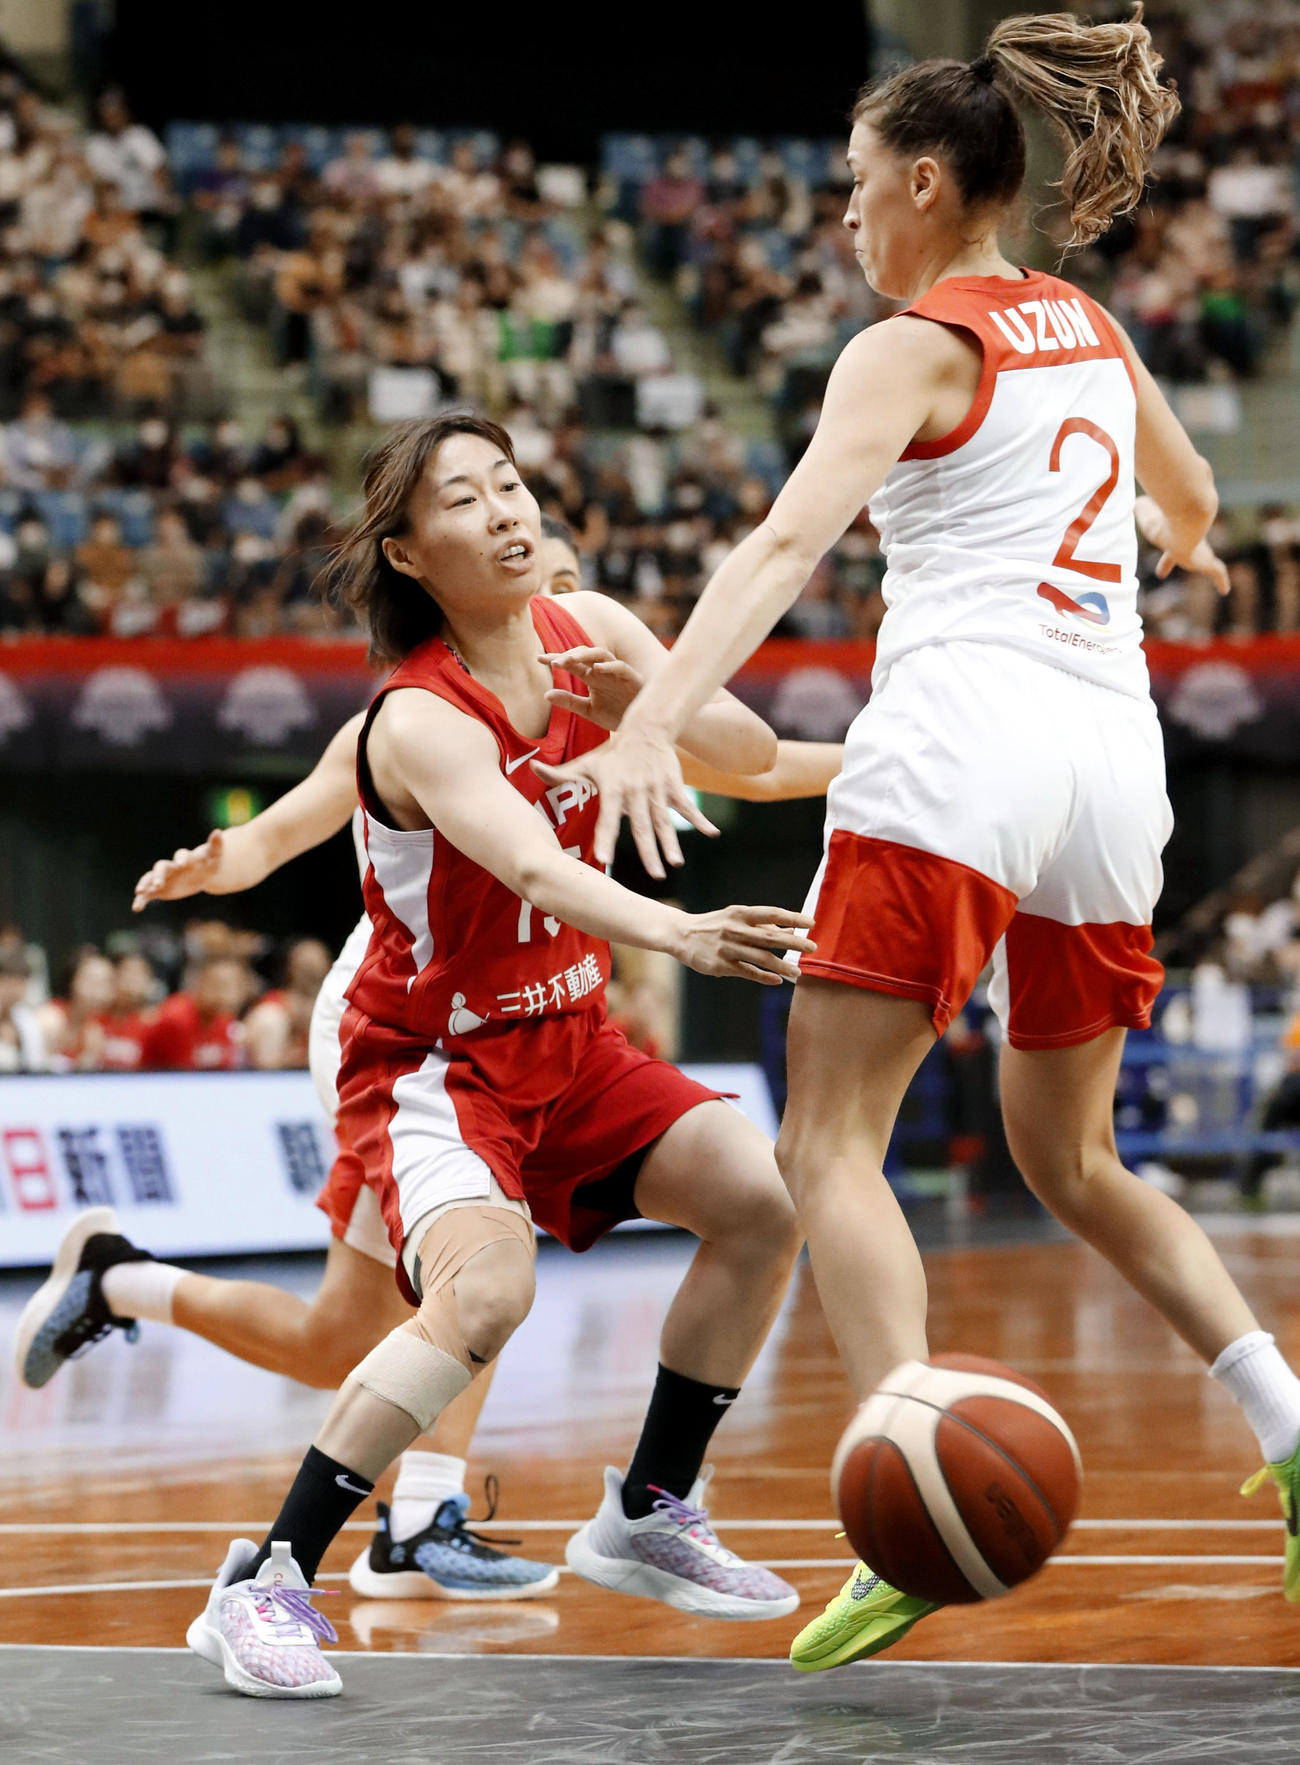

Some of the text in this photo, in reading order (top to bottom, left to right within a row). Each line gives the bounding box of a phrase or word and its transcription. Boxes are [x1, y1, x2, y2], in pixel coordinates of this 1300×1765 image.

[989, 298, 1100, 355] UZUN
[1049, 416, 1122, 584] 2
[1038, 623, 1123, 655] TotalEnerg
